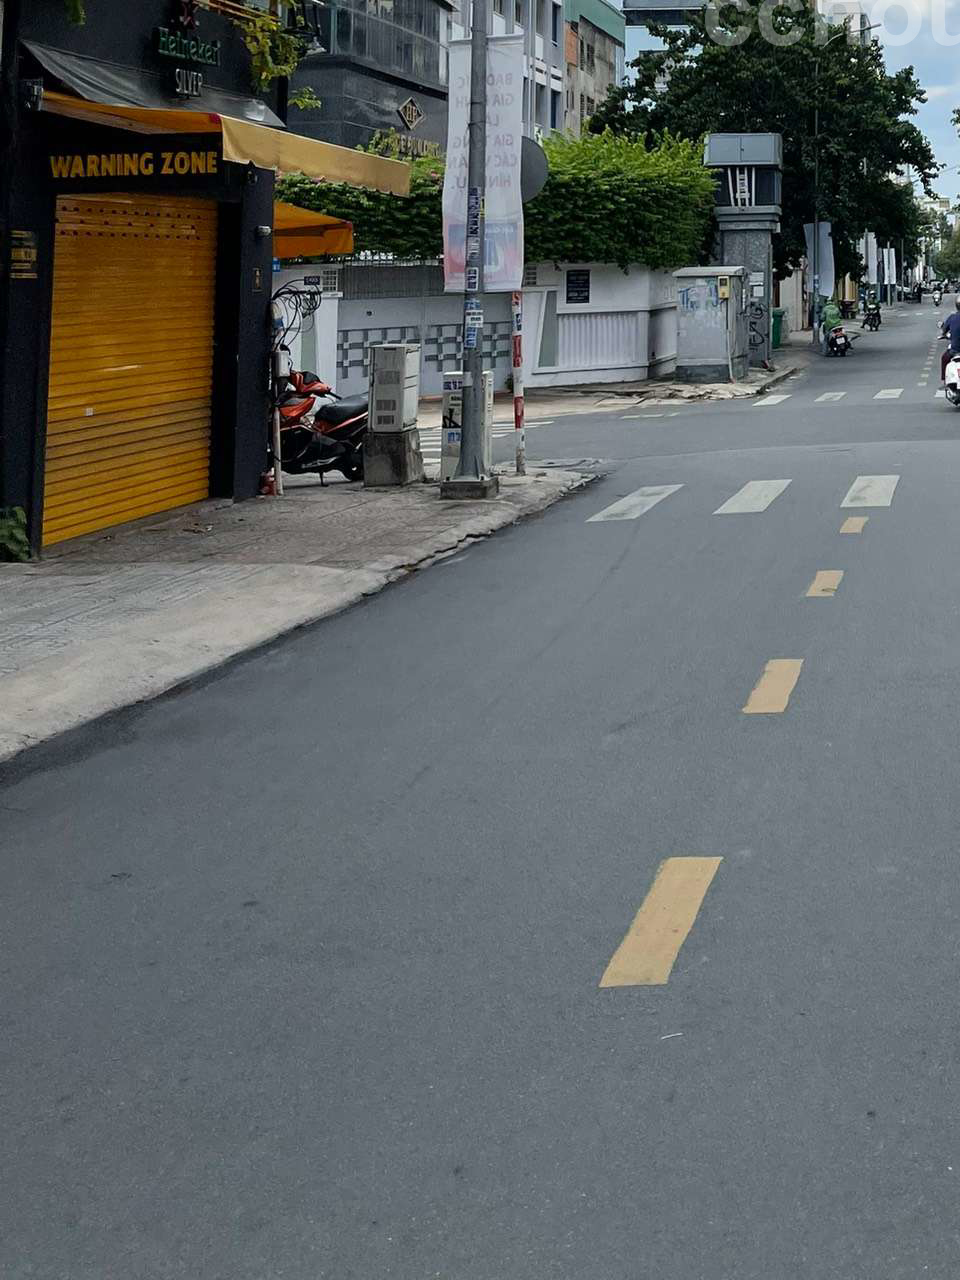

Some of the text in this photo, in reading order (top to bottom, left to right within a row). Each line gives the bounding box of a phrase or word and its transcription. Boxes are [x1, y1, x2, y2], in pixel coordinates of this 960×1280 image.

[158, 26, 220, 66] Heineken
[50, 151, 217, 179] WARNING ZONE
